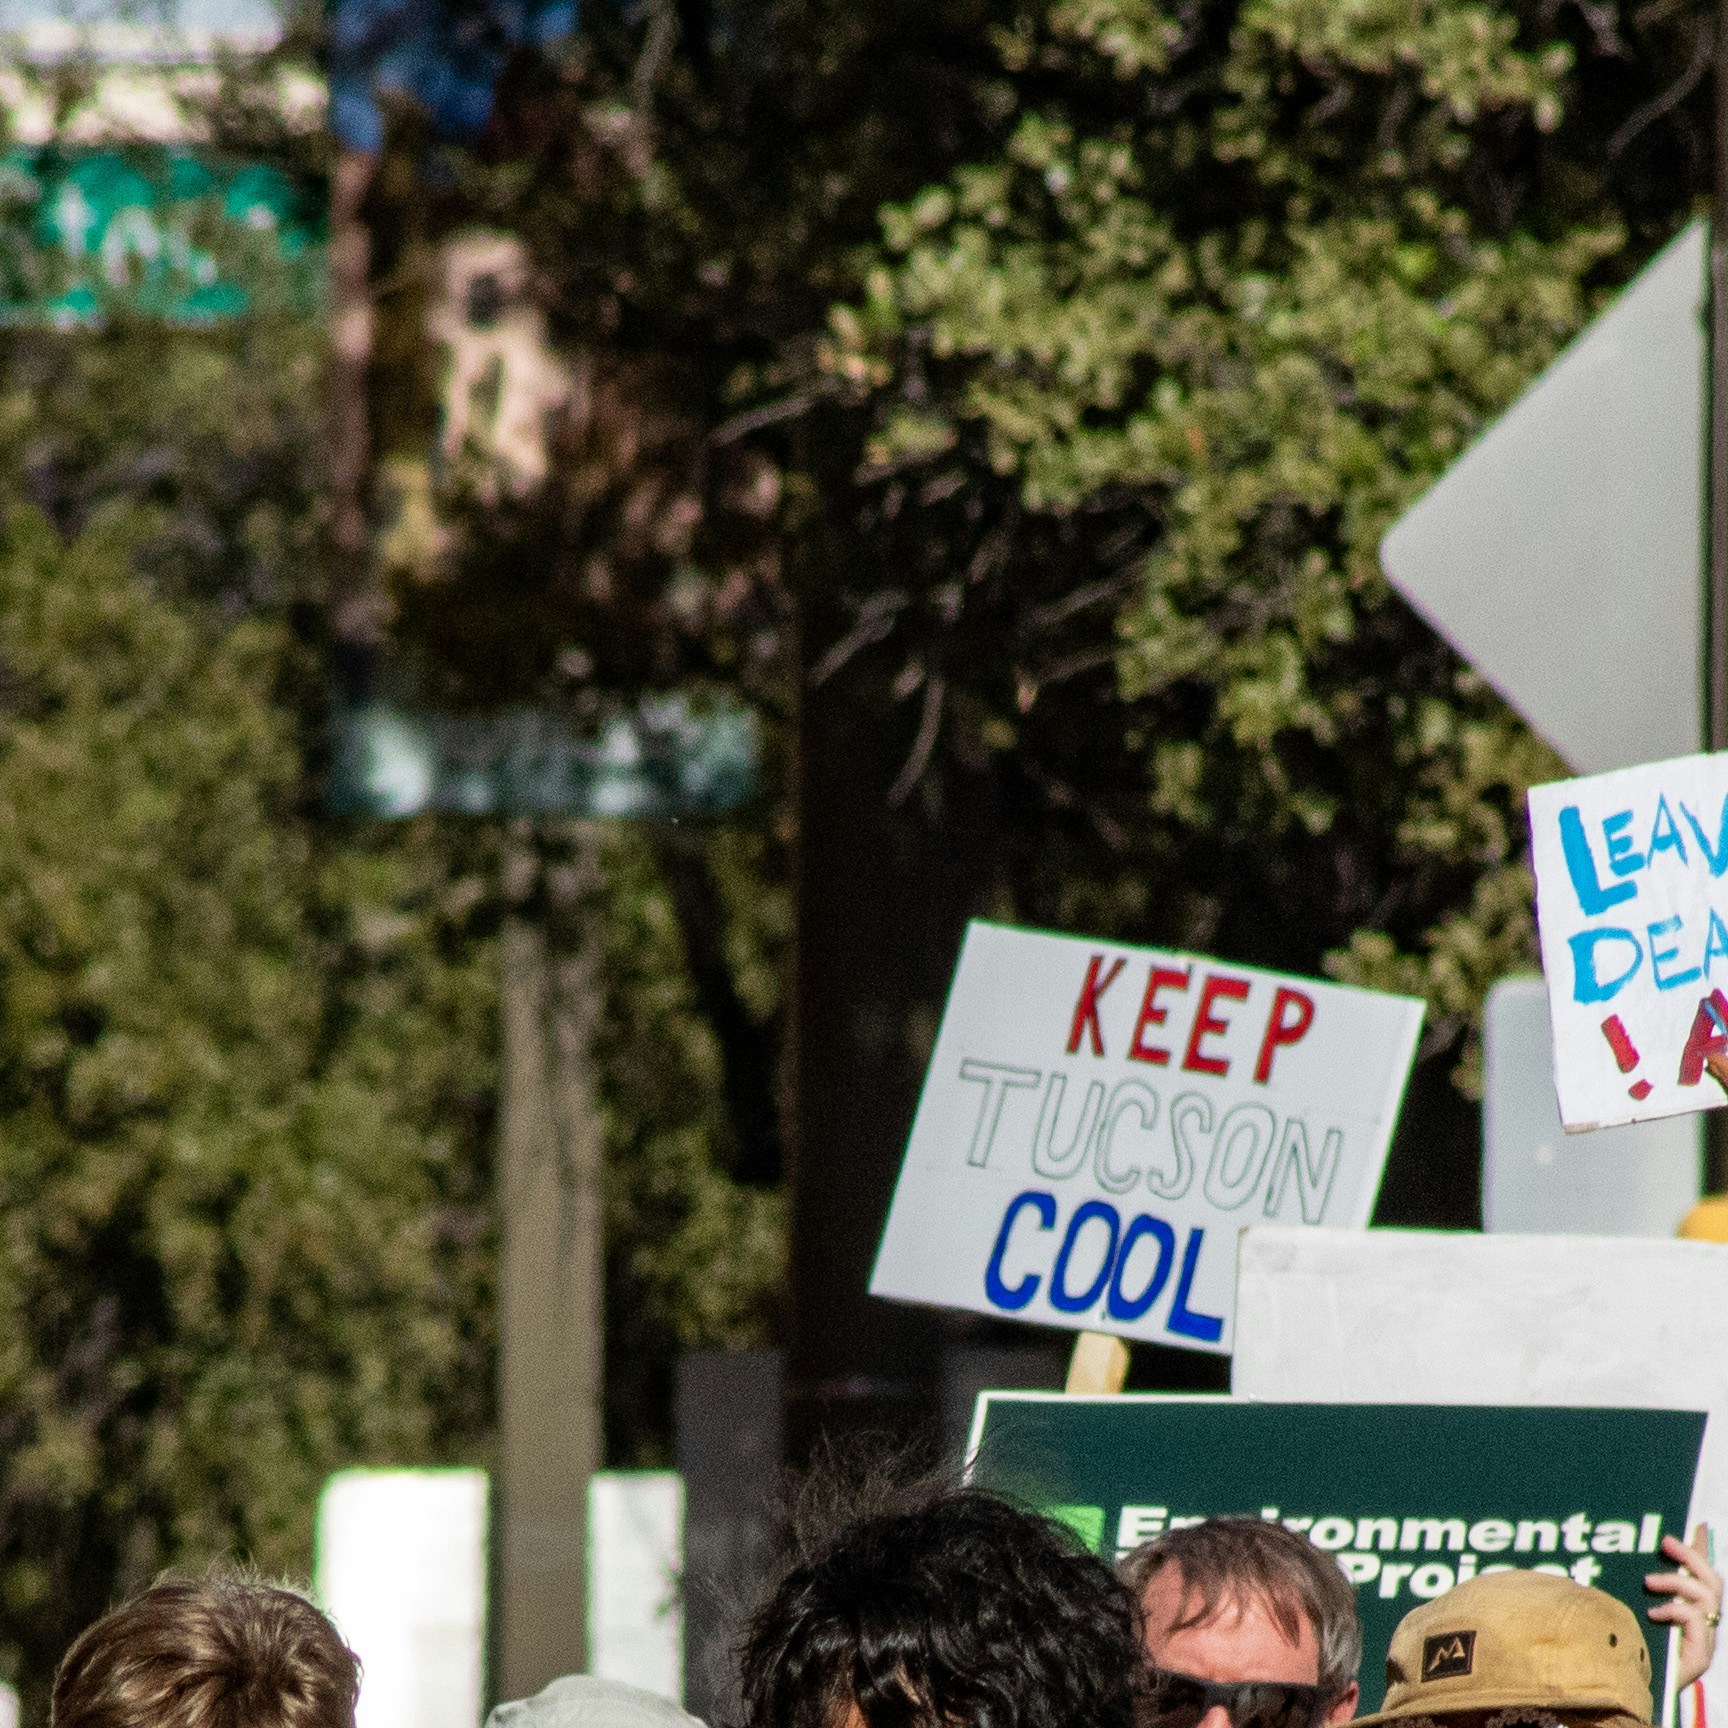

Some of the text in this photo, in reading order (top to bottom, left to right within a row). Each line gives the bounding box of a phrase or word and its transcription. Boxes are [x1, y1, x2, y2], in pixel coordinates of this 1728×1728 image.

[1065, 954, 1317, 1086] KEEP
[958, 1057, 1343, 1227] TUCSON
[984, 1190, 1224, 1343] COOL
[1334, 1552, 1603, 1600] Projt
